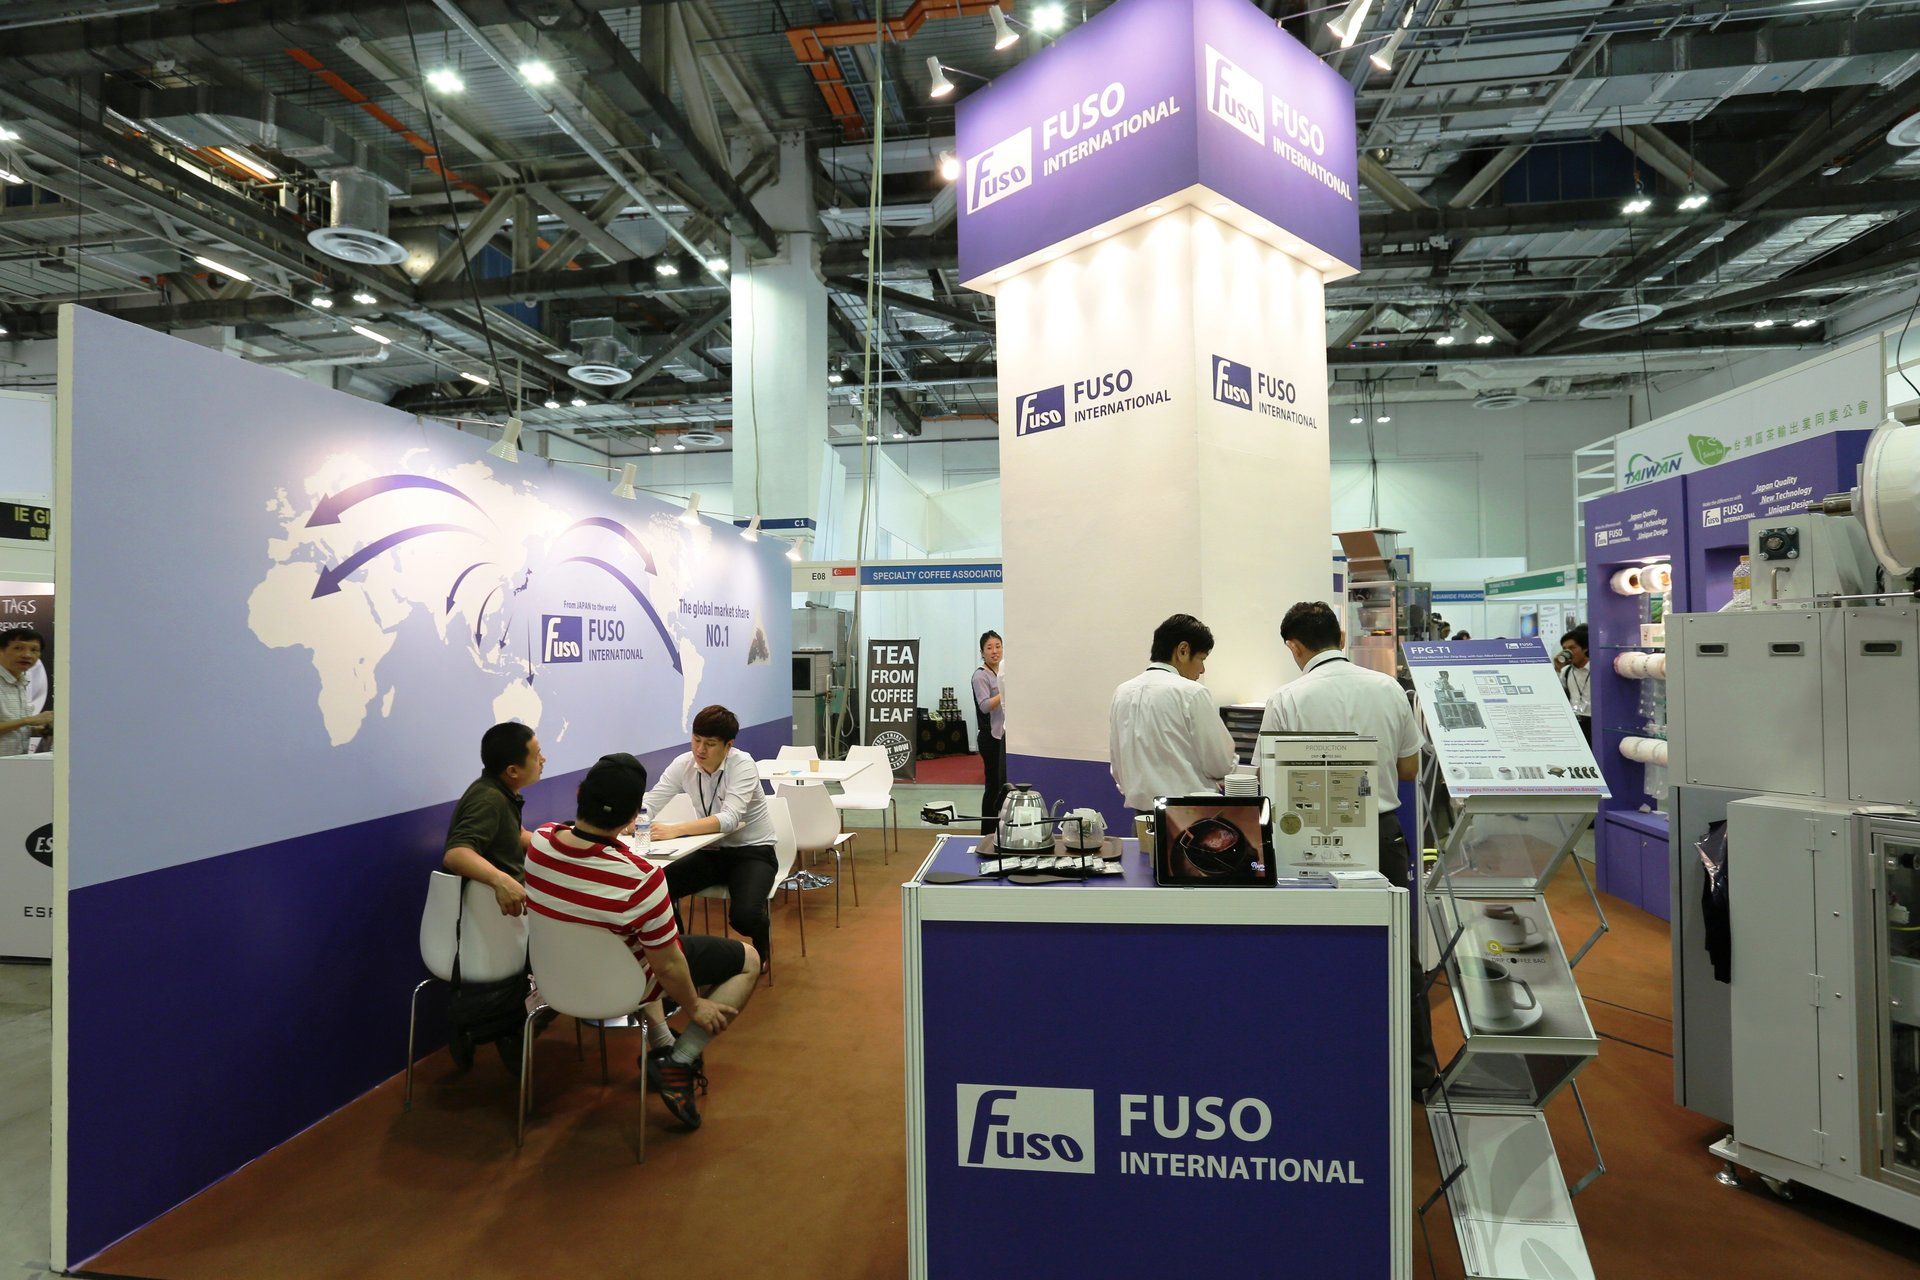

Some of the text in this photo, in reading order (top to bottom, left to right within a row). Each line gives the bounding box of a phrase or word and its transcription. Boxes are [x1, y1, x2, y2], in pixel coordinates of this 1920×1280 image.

[1043, 82, 1125, 150] FUSO
[1272, 94, 1325, 156] FUSO
[1043, 96, 1181, 176] INTERNATIONAL
[1273, 136, 1352, 201] INTERNATIONAL
[1074, 369, 1133, 403] FUSO
[1258, 372, 1296, 404] FUSO
[1074, 389, 1171, 423] INTERNATIONAL
[1258, 402, 1317, 429] INTERNATIONAL
[1625, 456, 1682, 485] TAIWAN
[1755, 476, 1798, 493] Japan Quality
[1761, 486, 1813, 503] New Technology
[1643, 508, 1658, 518] Quality
[1723, 503, 1744, 516] FUSO
[1768, 499, 1814, 515] Unique Design
[794, 519, 805, 528] C1
[1644, 518, 1668, 528] Technology
[1723, 512, 1756, 524] INTERNATIONAL
[1609, 528, 1623, 538] FUSO
[1653, 528, 1668, 537] Design
[811, 572, 826, 581] E08
[873, 571, 916, 581] SPECIALTY
[918, 570, 950, 580] COFFEE
[2, 598, 36, 615] TAGS
[563, 600, 576, 609] From
[577, 601, 592, 610] JAPAN
[597, 603, 605, 611] the
[605, 604, 617, 612] world
[679, 598, 749, 619] The global market share
[589, 619, 625, 641] FUSO
[706, 624, 729, 647] NO.1
[589, 648, 644, 662] INTERNATIONAL
[872, 645, 915, 665] TEA
[1410, 646, 1451, 655] FPG-T1
[871, 670, 914, 684] FROM
[871, 688, 913, 703] COFFEE
[870, 707, 913, 723] LEAF
[893, 742, 909, 753] NOW
[1120, 1094, 1272, 1142] FUSO
[1120, 1151, 1364, 1184] INTERNATIONAL
